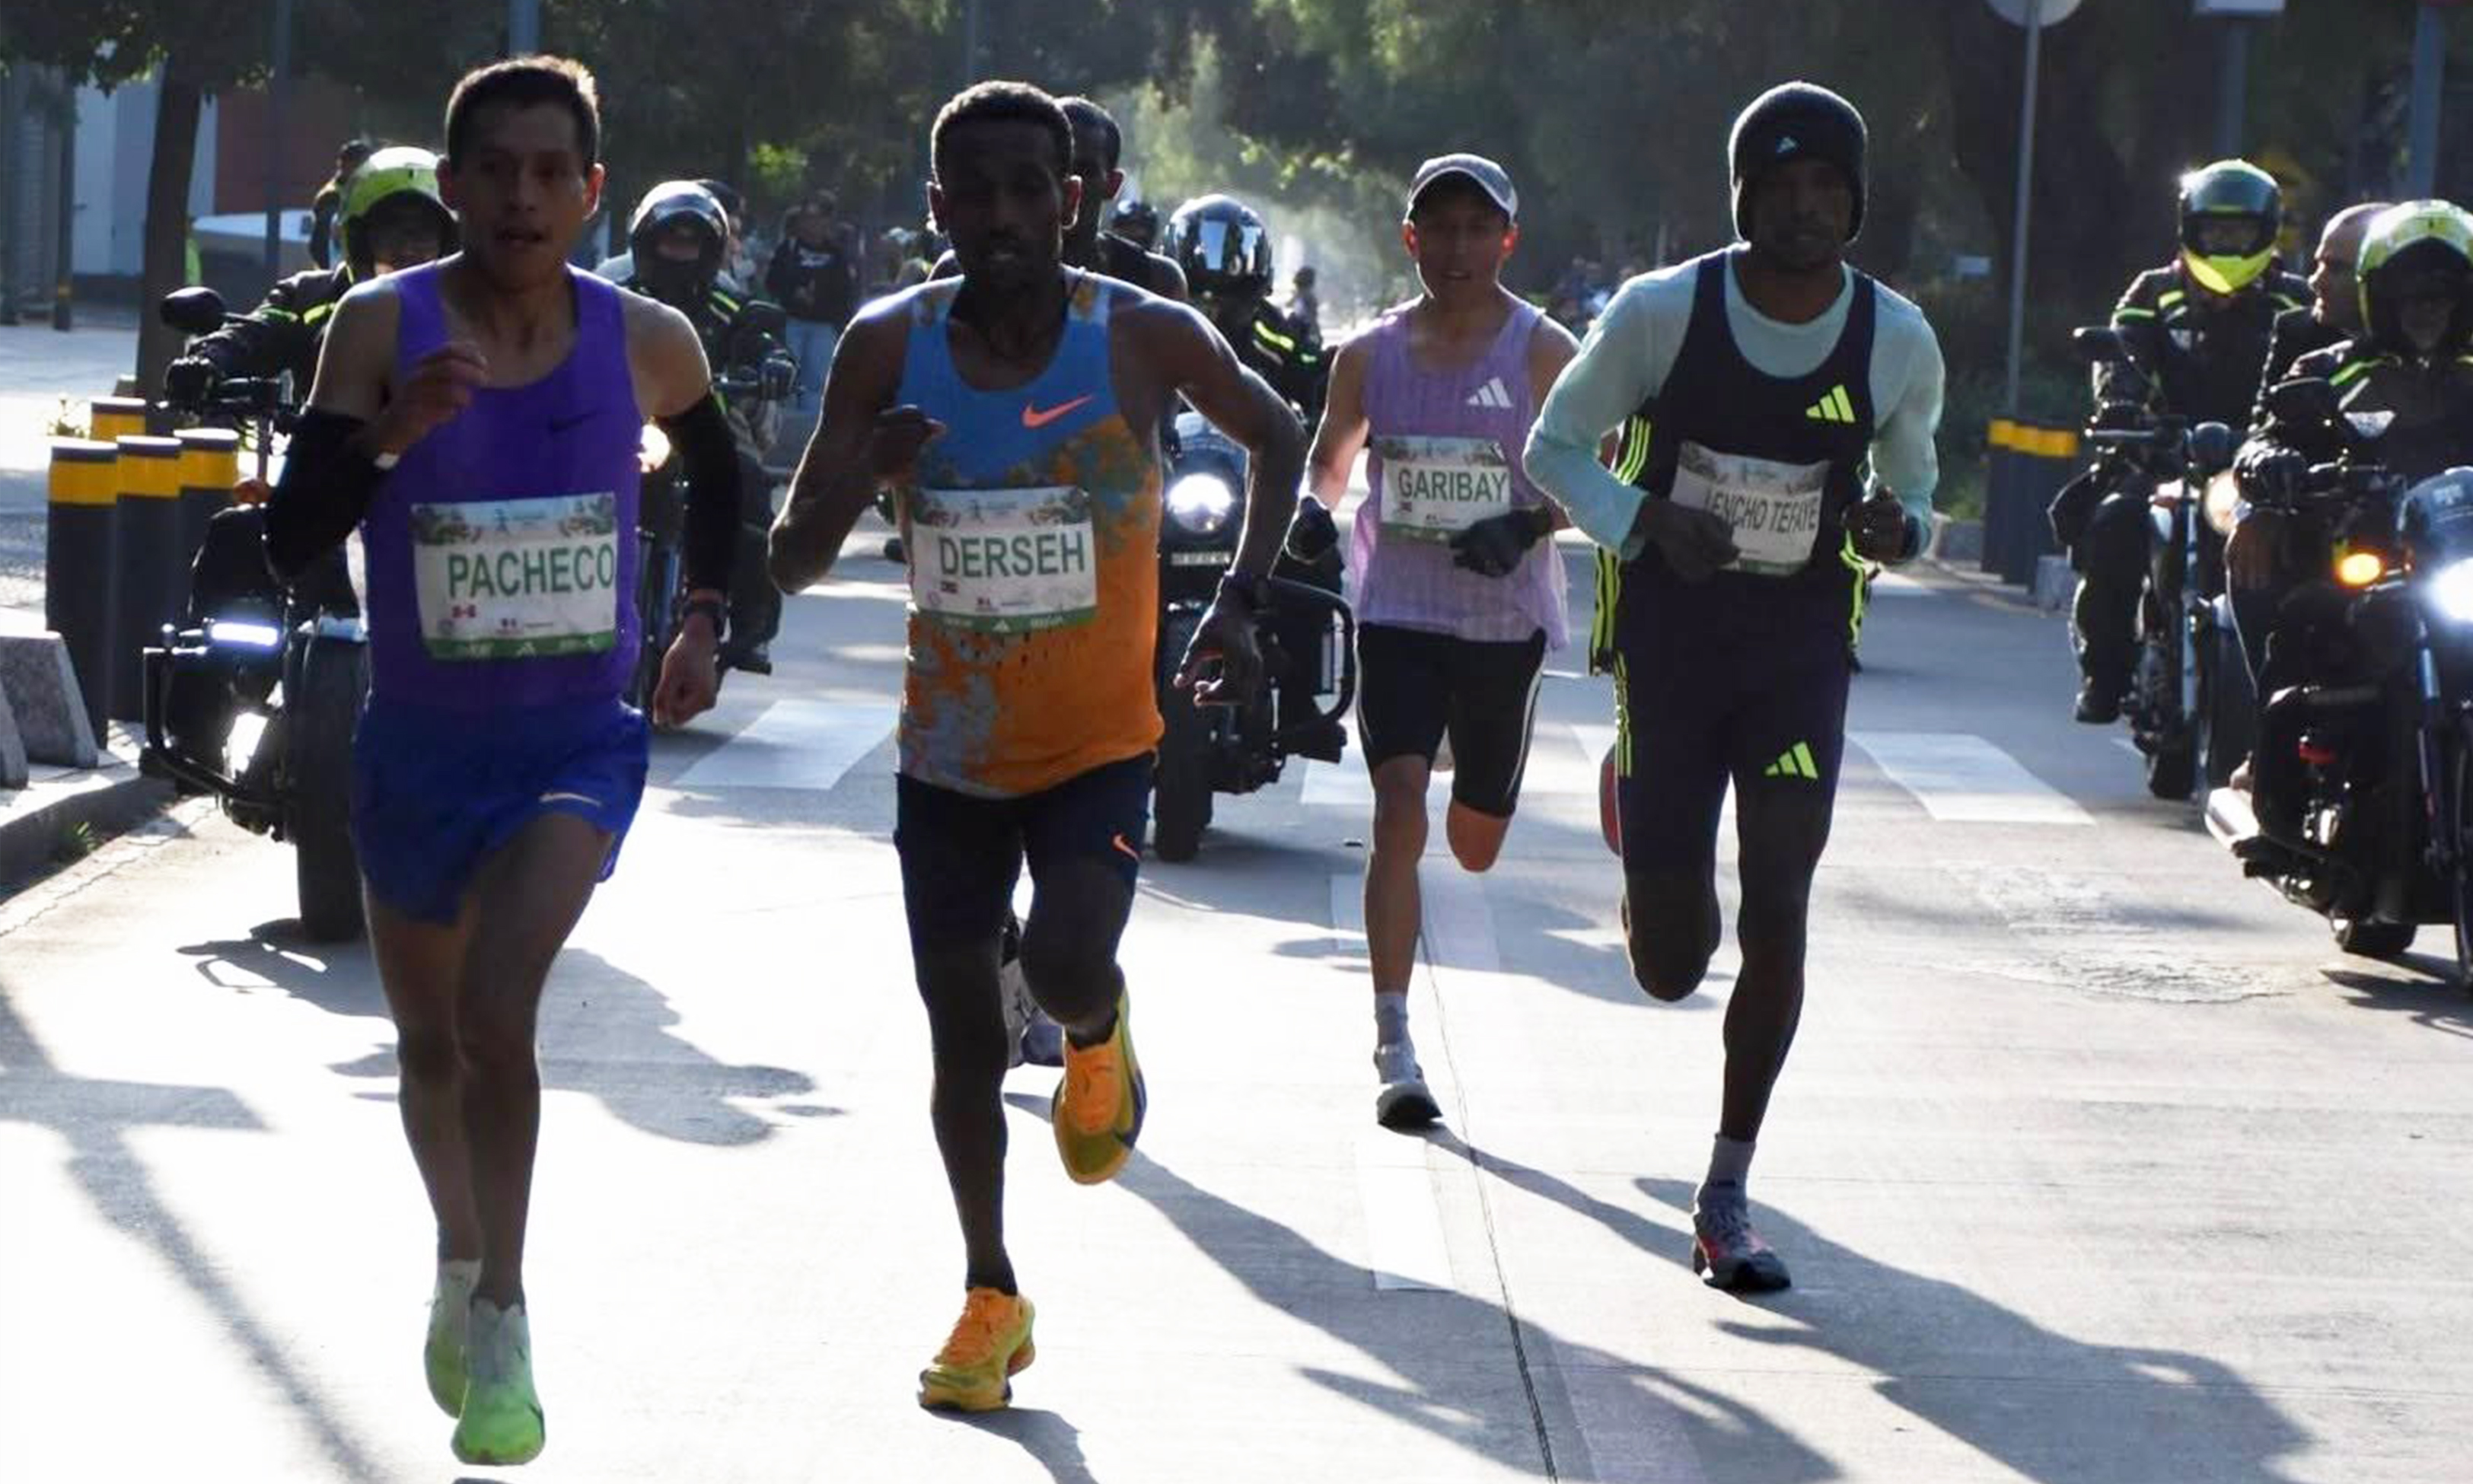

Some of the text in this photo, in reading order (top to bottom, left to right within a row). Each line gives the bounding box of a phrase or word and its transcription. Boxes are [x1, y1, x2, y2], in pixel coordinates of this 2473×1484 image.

[1397, 469, 1507, 502] GARIBAY
[448, 544, 614, 598] PACHECO
[939, 531, 1085, 578] DERSEH
